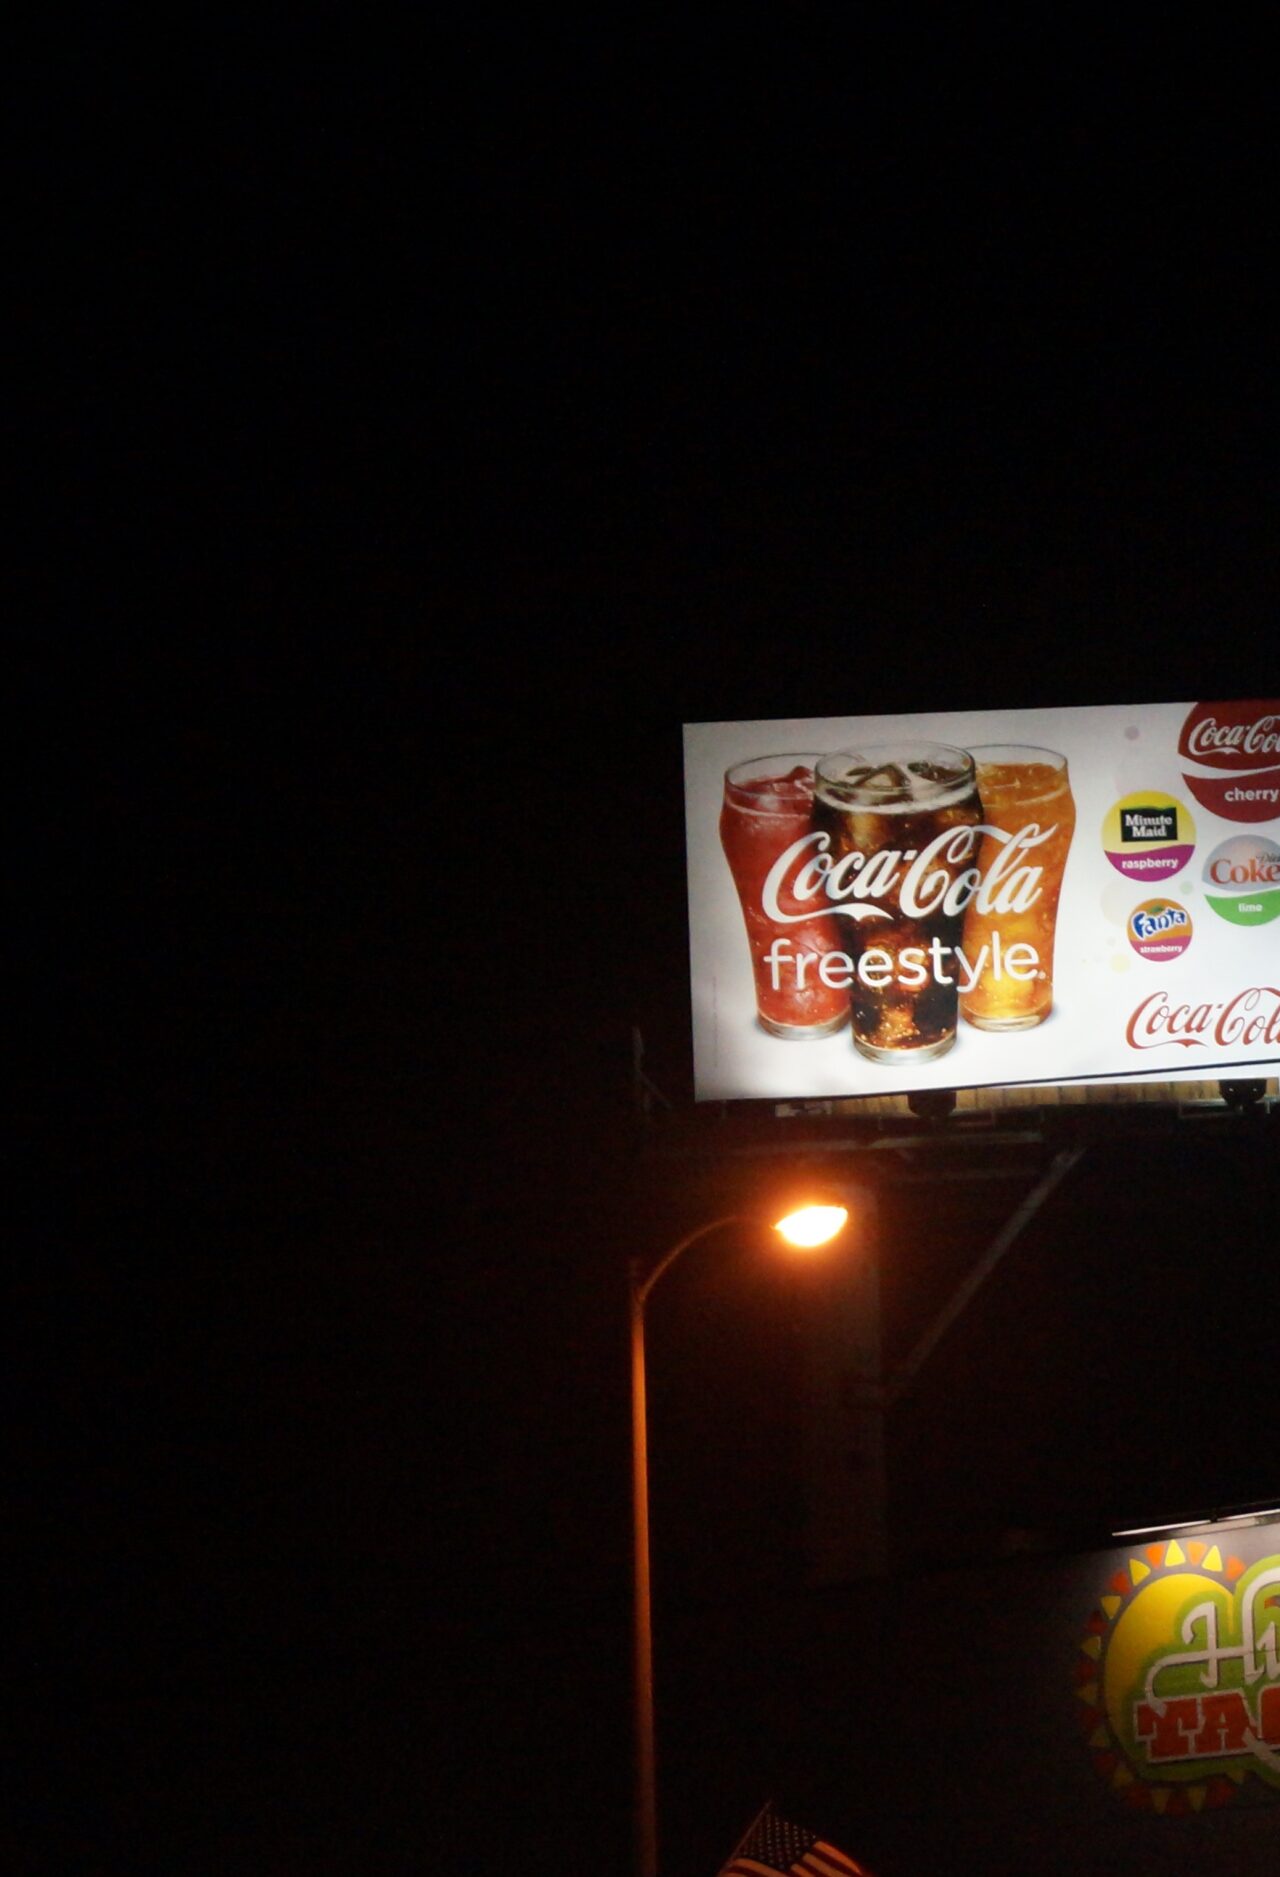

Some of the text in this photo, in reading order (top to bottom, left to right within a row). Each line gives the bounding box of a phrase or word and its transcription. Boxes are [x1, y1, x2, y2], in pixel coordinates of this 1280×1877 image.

[1224, 786, 1279, 802] cherry
[1125, 814, 1173, 827] Minute
[1132, 825, 1167, 838] Maid
[1121, 857, 1179, 870] raspberry
[762, 823, 1058, 923] Coca-Cola
[1238, 902, 1263, 913] lime
[1131, 907, 1187, 940] Fanta
[763, 931, 1040, 992] freestyle
